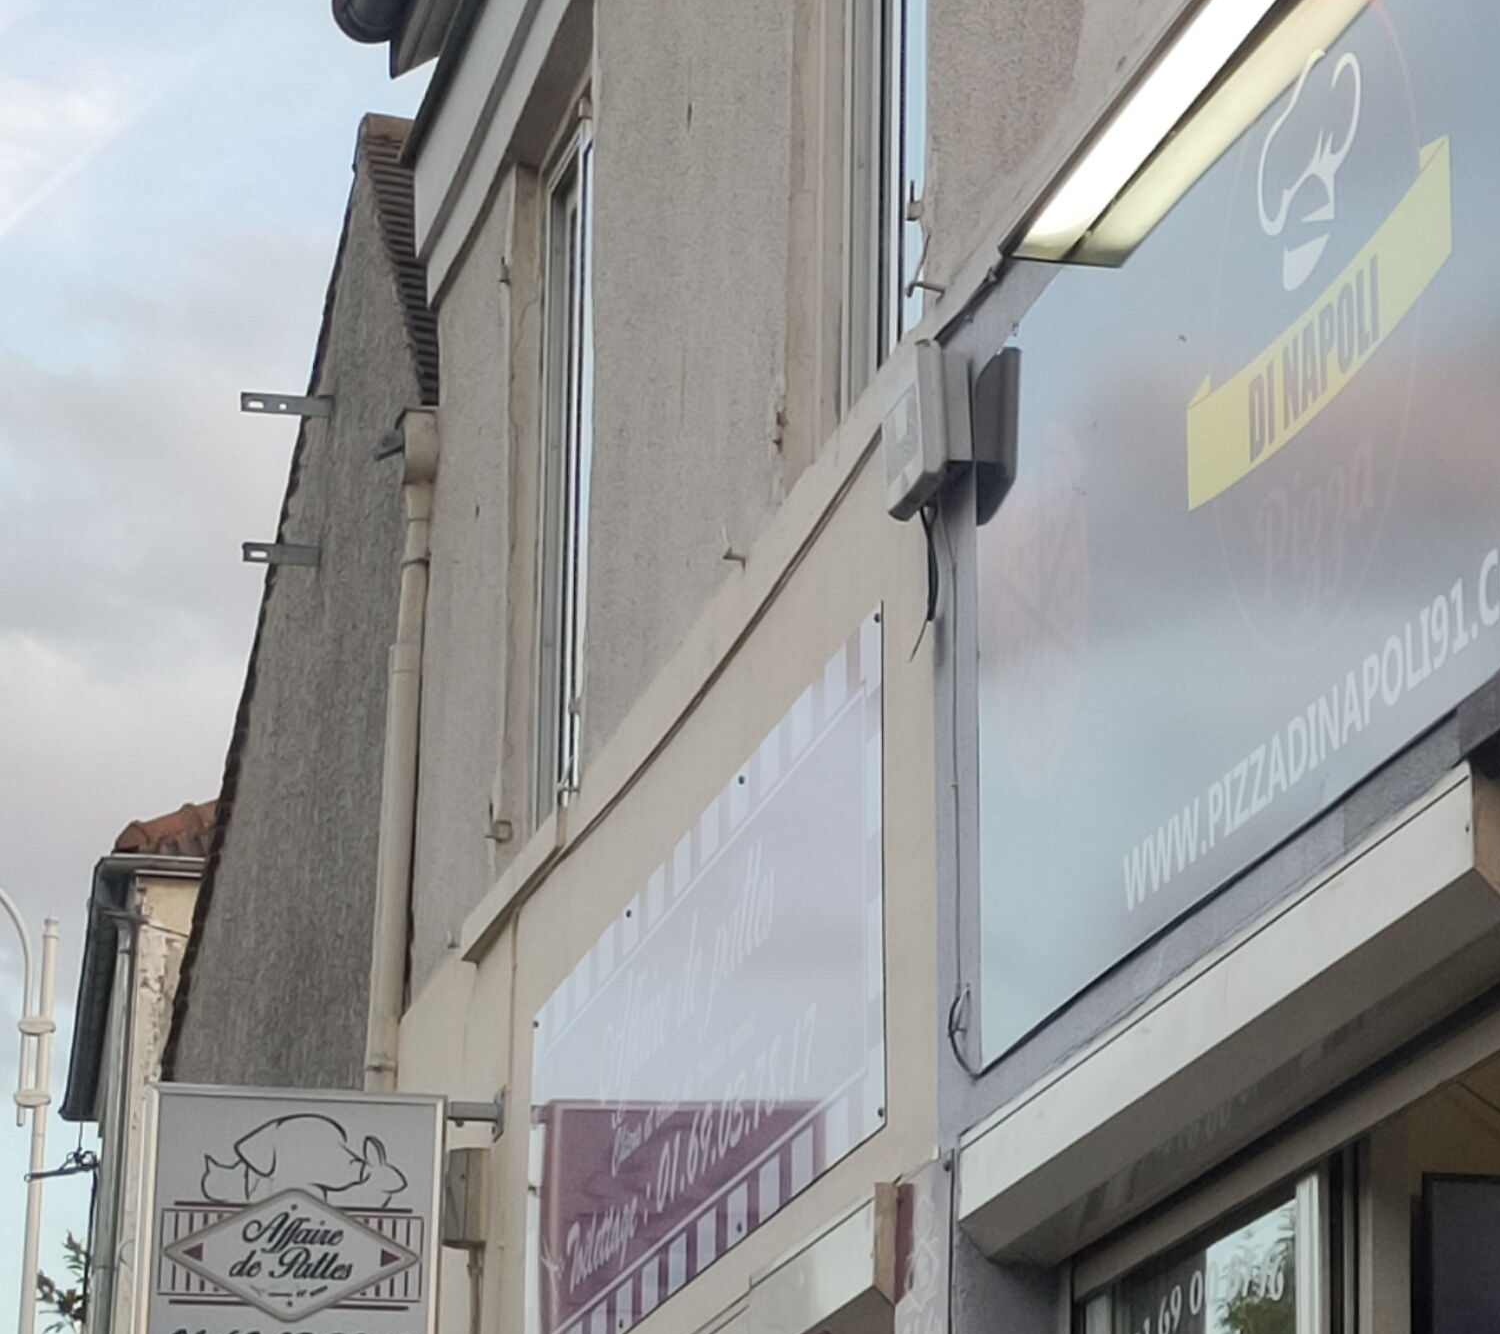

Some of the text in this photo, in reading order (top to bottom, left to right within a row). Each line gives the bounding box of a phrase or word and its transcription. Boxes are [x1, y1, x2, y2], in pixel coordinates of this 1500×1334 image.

[1246, 252, 1381, 465] DI NAPOLI
[242, 1211, 344, 1253] Affaire
[229, 1250, 262, 1278] de
